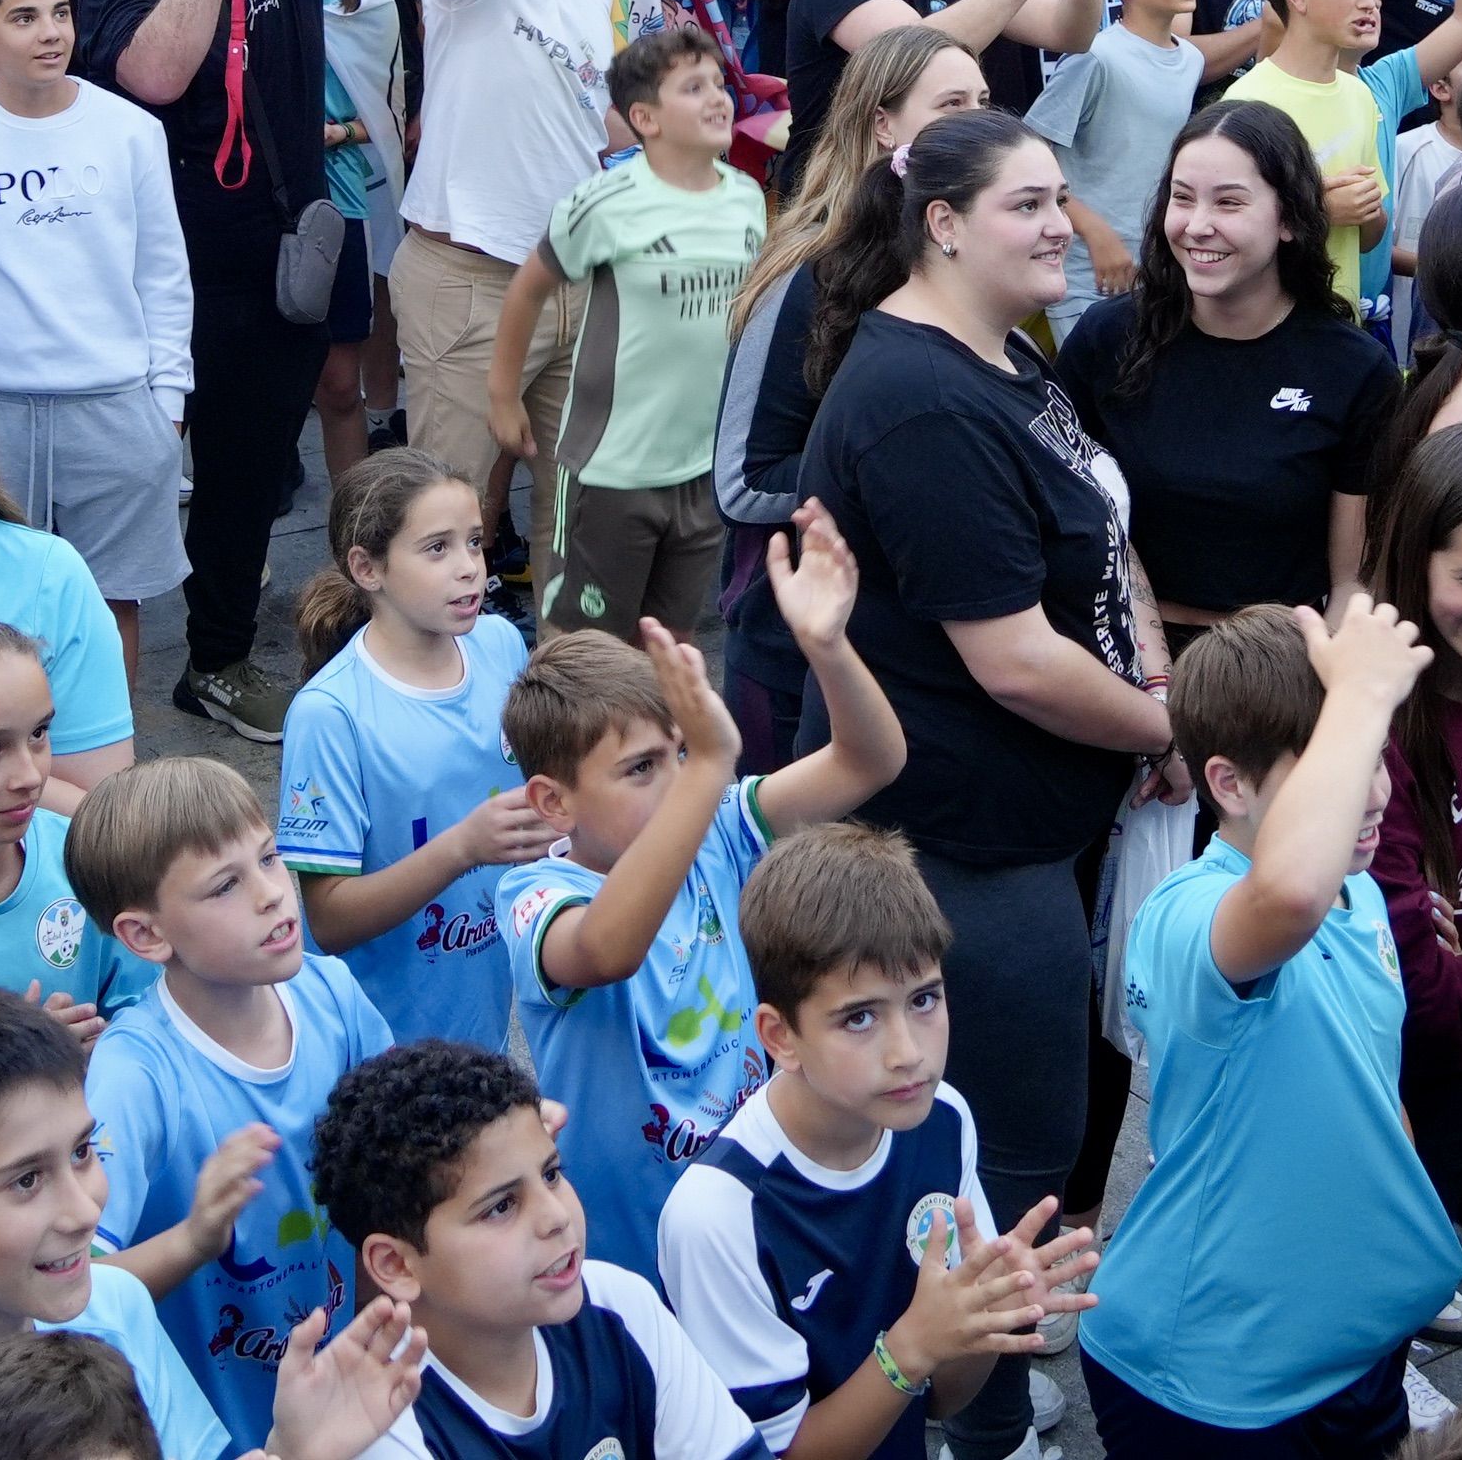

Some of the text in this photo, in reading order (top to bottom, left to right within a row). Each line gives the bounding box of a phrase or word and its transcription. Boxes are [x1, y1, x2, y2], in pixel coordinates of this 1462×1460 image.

[1277, 387, 1304, 401] NIKE
[1290, 400, 1311, 412] AIR
[208, 683, 233, 707] PUMA
